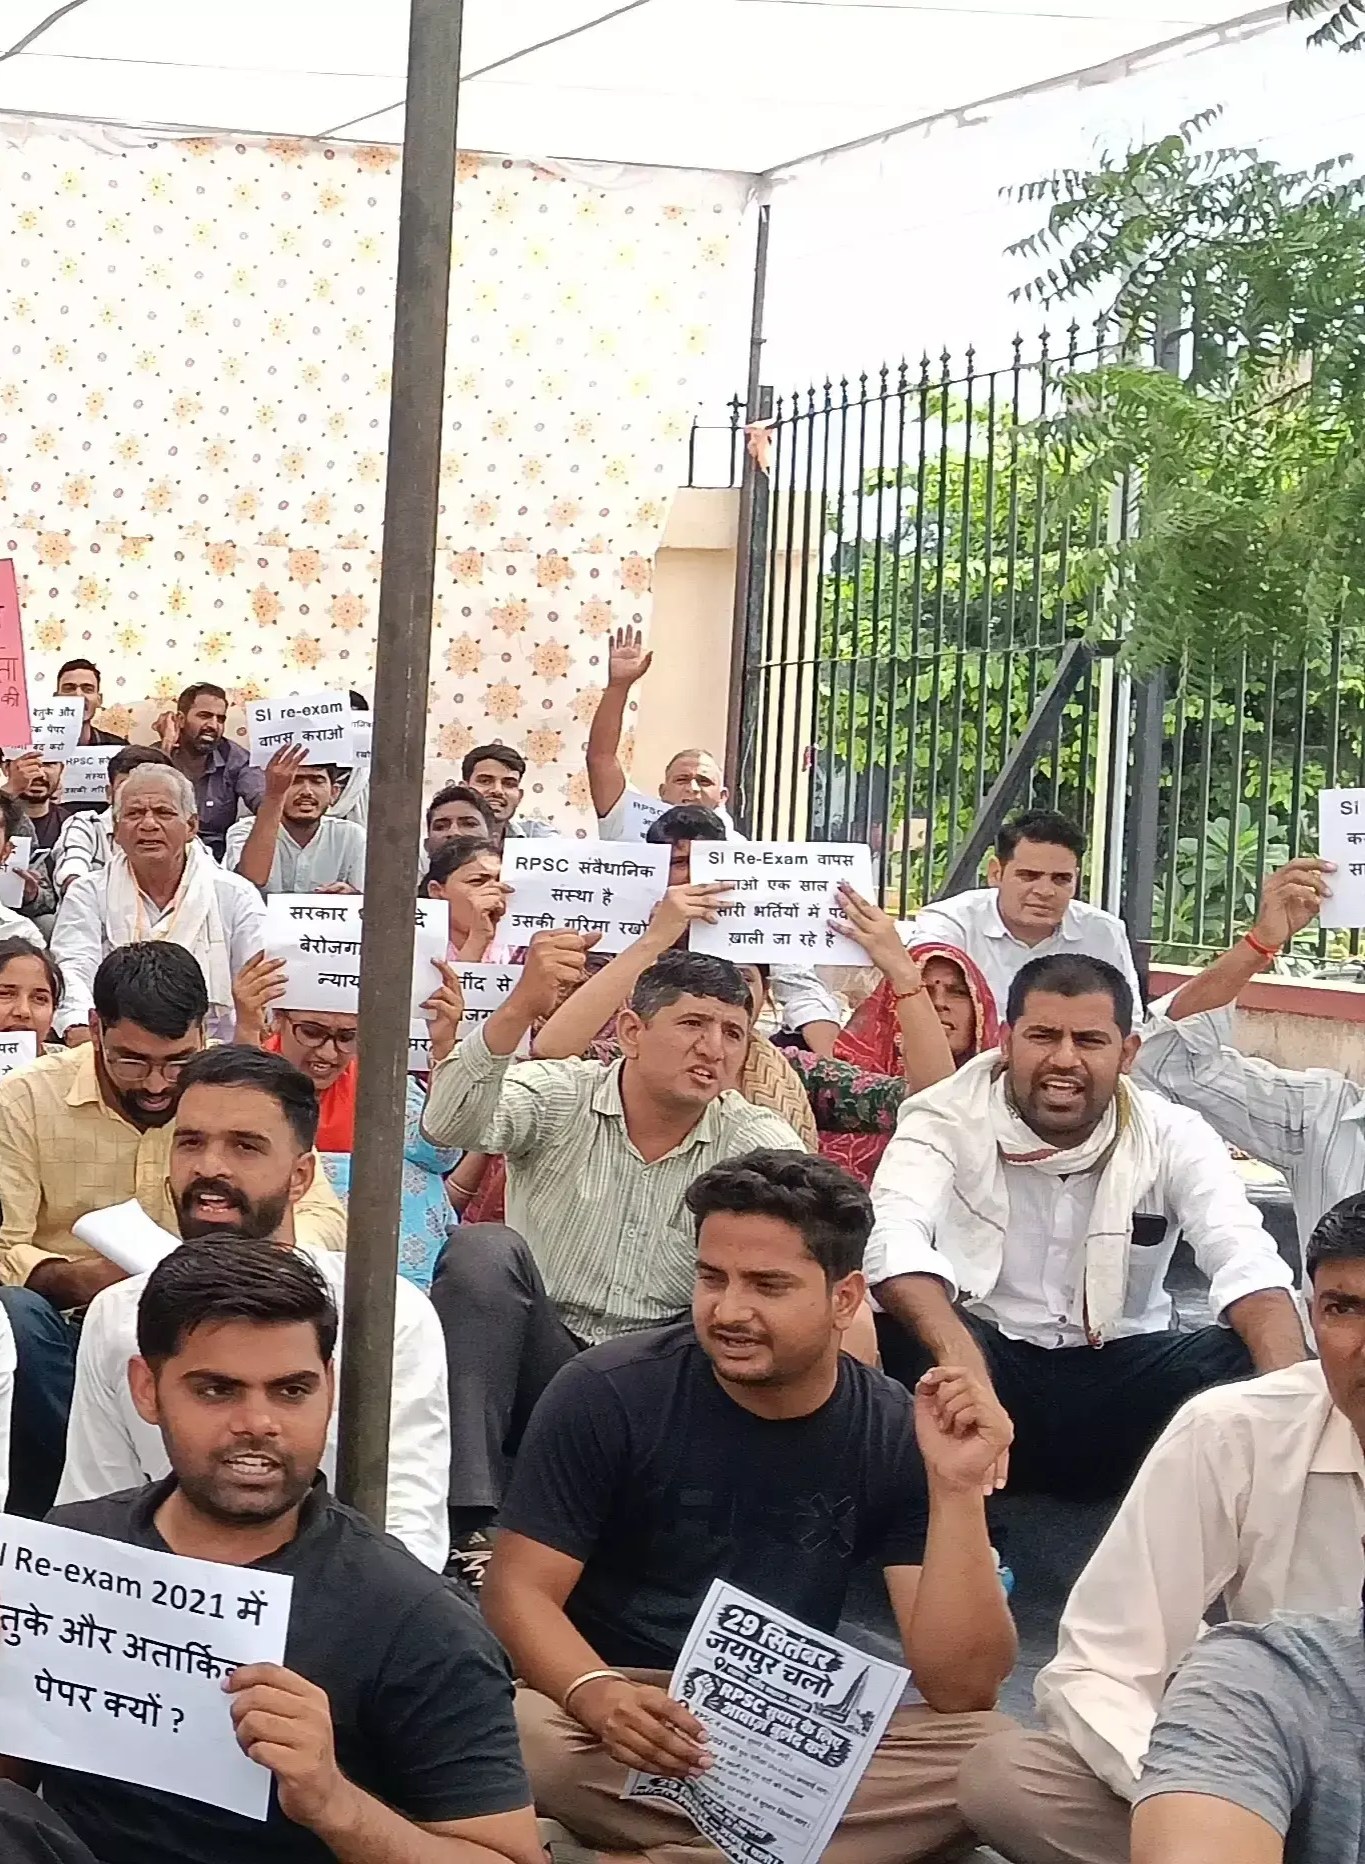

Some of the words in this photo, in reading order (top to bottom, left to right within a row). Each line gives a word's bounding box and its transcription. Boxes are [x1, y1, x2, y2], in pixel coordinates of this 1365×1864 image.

[254, 708, 272, 722] SI
[280, 701, 343, 719] re-exam
[302, 725, 345, 742] कराओ
[1340, 801, 1359, 815] Si
[515, 857, 569, 873] RPSC
[708, 851, 725, 865] SI
[734, 851, 808, 866] Re-Exam
[817, 853, 855, 868] वापस
[767, 879, 791, 891] एक
[799, 879, 828, 892] साल
[290, 907, 348, 923] सरकार
[512, 912, 555, 930] उसकी
[773, 930, 791, 946] जा
[799, 930, 817, 947] रहे
[14, 1546, 143, 1599] Re-exam
[151, 1579, 225, 1620] 2021
[236, 1589, 269, 1627] में
[722, 1608, 760, 1636] 29
[58, 1613, 117, 1654] और
[706, 1629, 781, 1675] जयपुर
[783, 1663, 834, 1698] चलो
[34, 1667, 97, 1714] पेपर
[104, 1687, 163, 1728] क्यों
[170, 1706, 185, 1734] ?
[719, 1682, 767, 1713] RPSC
